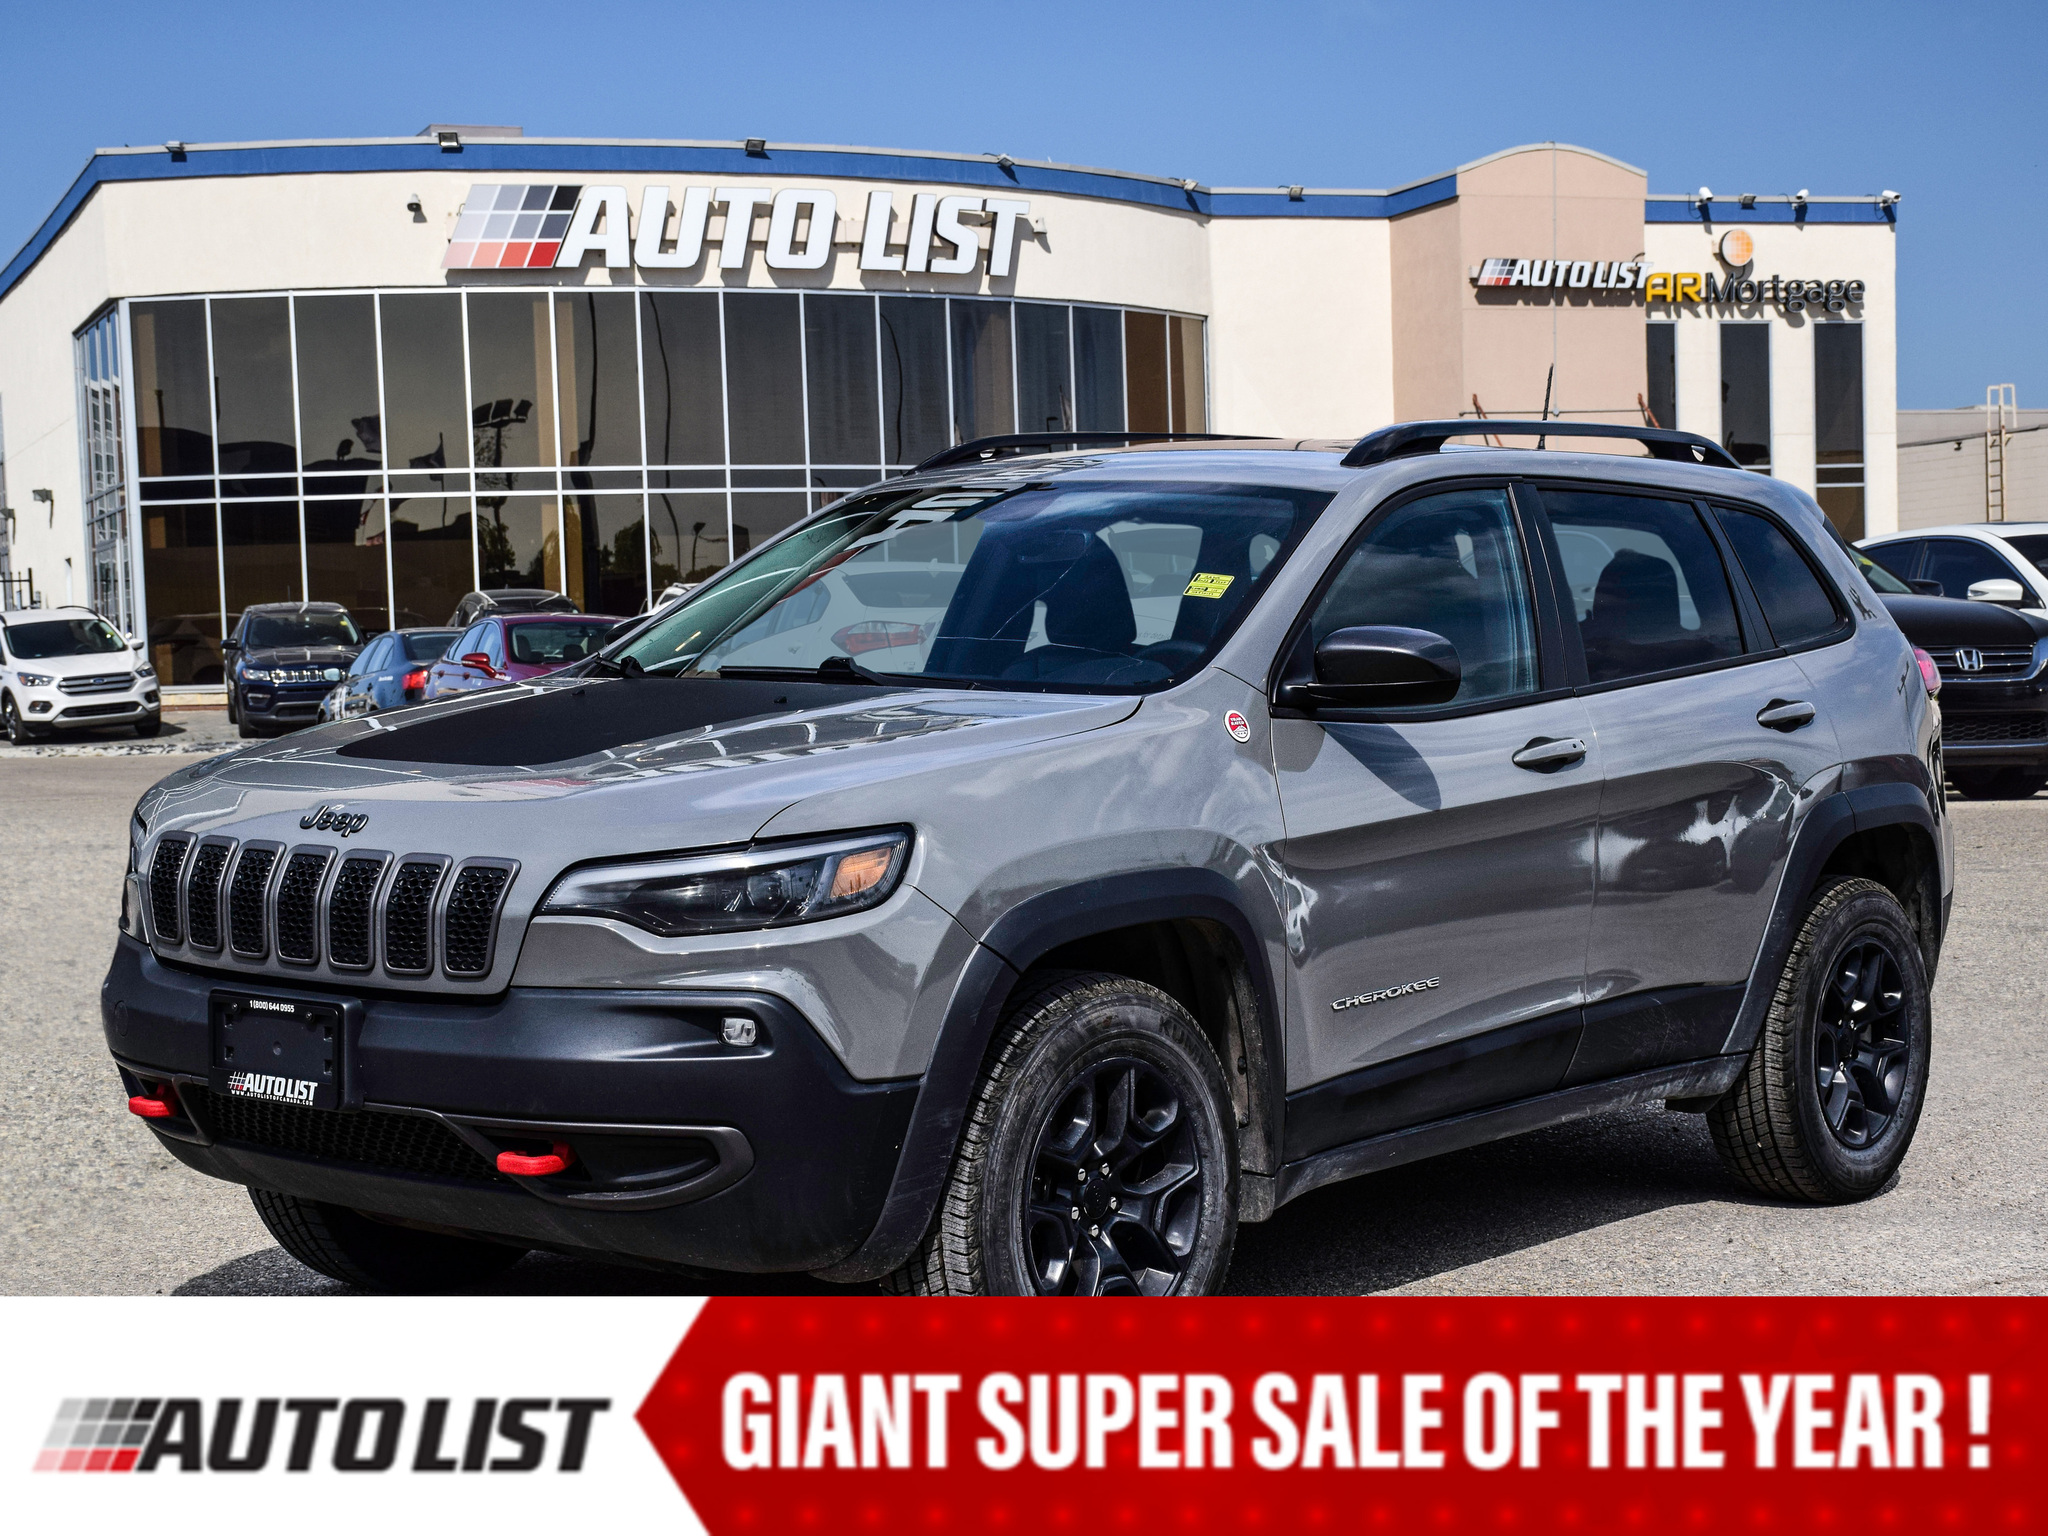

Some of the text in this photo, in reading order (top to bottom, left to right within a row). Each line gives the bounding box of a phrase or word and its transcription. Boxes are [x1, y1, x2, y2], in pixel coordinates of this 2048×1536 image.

[555, 185, 1031, 277] AUTO LIST
[1645, 271, 1866, 313] AR Mortgage
[300, 805, 369, 838] Jeep
[269, 1002, 280, 1011] 644
[280, 1003, 295, 1013] 0955
[1330, 976, 1440, 1011] CHEROKEE
